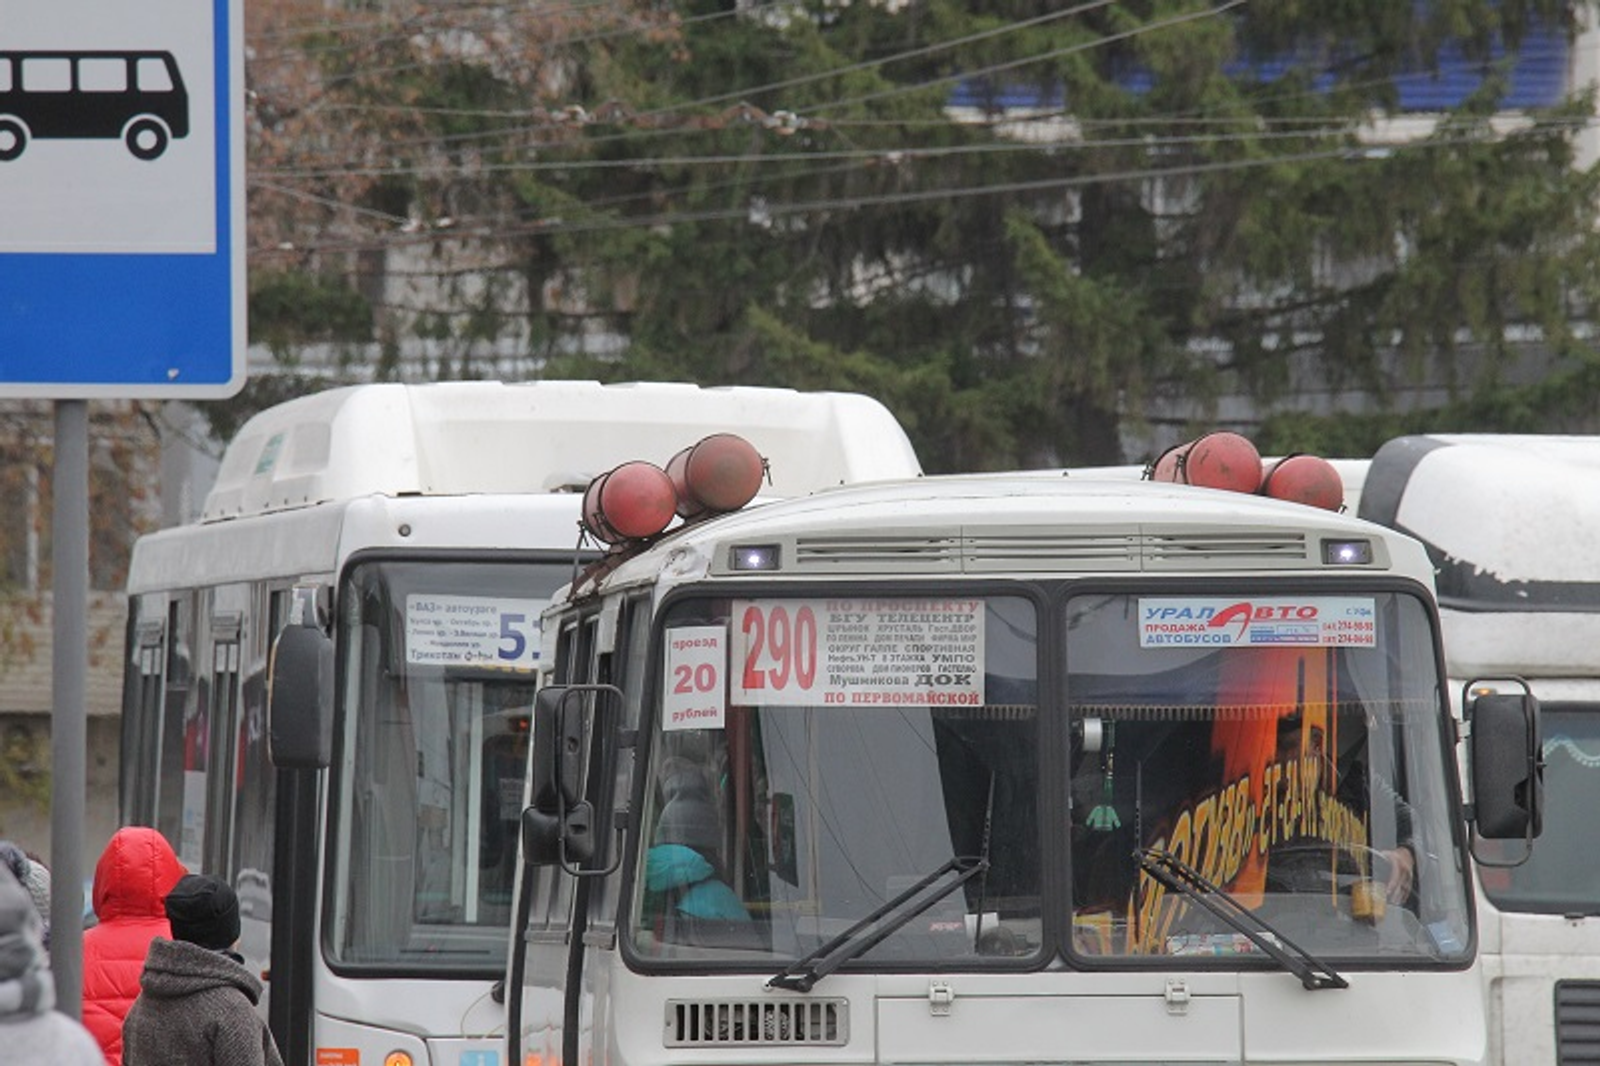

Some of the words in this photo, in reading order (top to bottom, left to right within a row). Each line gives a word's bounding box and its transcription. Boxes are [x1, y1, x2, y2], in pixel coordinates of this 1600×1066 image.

[860, 601, 979, 613] ПРОСПЕКТУ
[1146, 607, 1215, 619] УРАЛ
[830, 614, 867, 623] БГУ
[877, 614, 975, 623] ТЕЛЕЦЕНТР
[877, 624, 923, 633] ХРУСТАЛЬ
[1146, 624, 1206, 633] ПРОДАЖА
[672, 638, 718, 651] проезд
[1146, 634, 1231, 644] АВТОБУСОВ
[742, 606, 817, 691] 290
[828, 644, 861, 653] ОКРУГ
[904, 644, 975, 653] СПОРТИВНАЯ
[932, 654, 975, 663] УМПО
[673, 663, 717, 694] 20
[830, 674, 909, 688] Мушникова
[914, 674, 972, 687] ДОК
[824, 692, 846, 703] ПО
[852, 690, 979, 705] ПЕРВОМАЙСКОЙ
[672, 706, 718, 722] рублей
